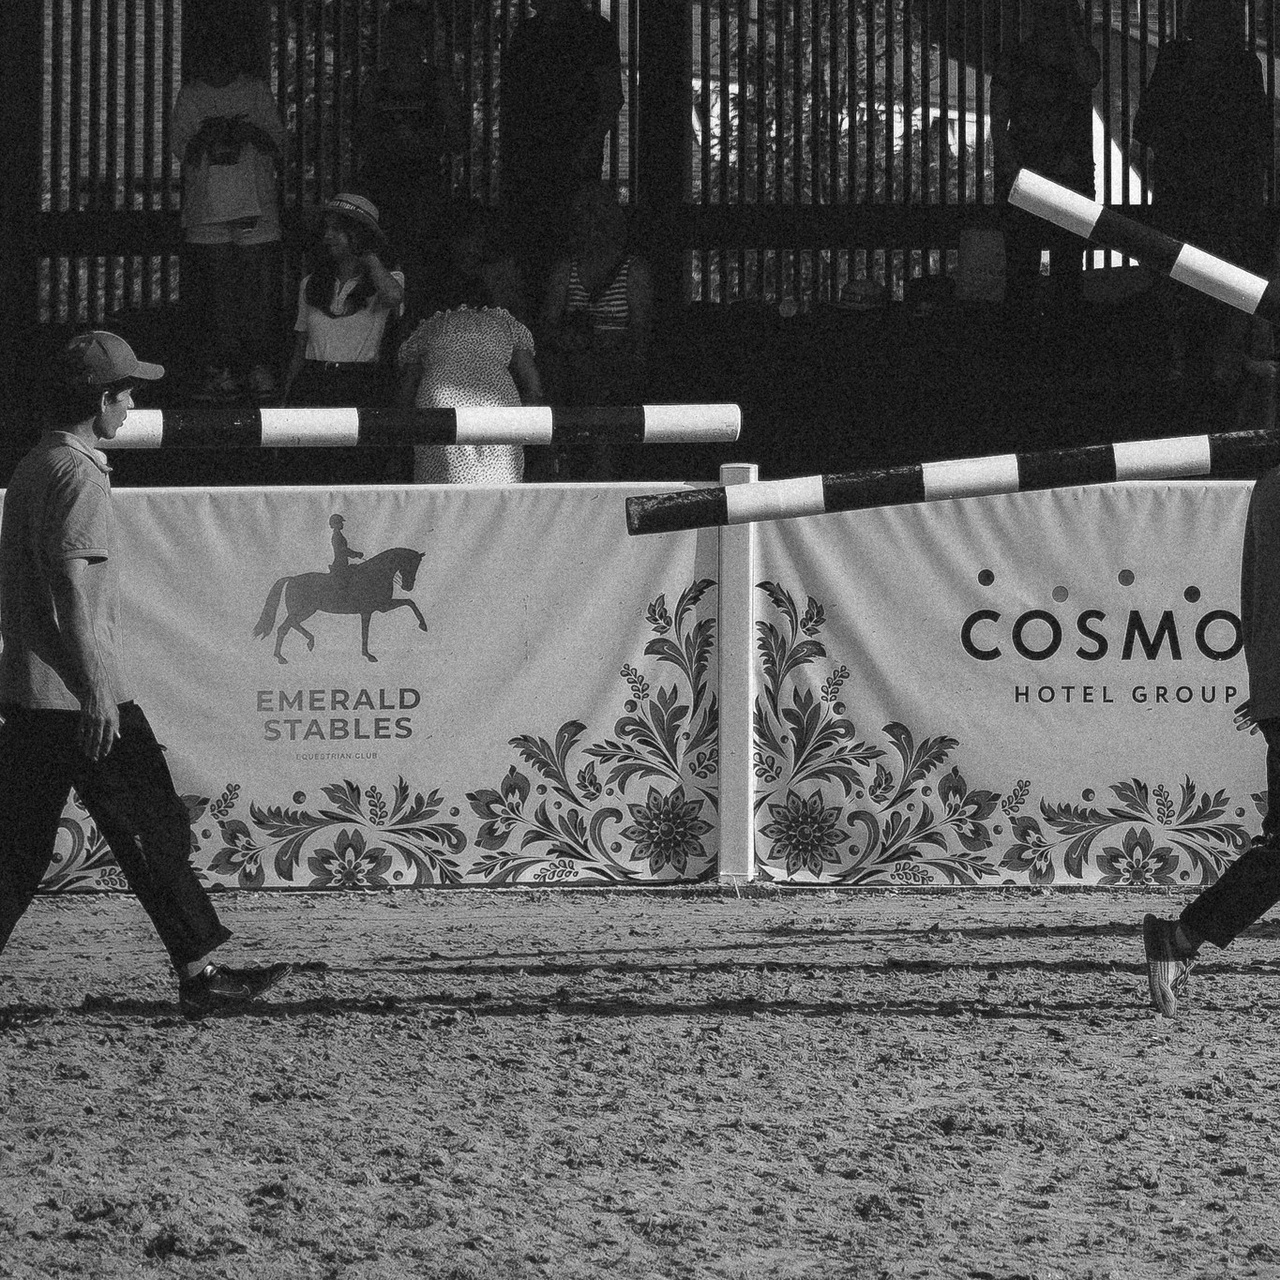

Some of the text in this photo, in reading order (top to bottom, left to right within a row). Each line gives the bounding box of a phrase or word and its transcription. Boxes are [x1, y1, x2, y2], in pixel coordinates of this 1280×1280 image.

[960, 609, 1245, 661] COSMO
[256, 688, 421, 712] EMERALD
[1014, 686, 1238, 704] HOTEL GROUP
[263, 717, 413, 741] STABLES
[296, 752, 378, 761] EQUESTRIAN CLUB
